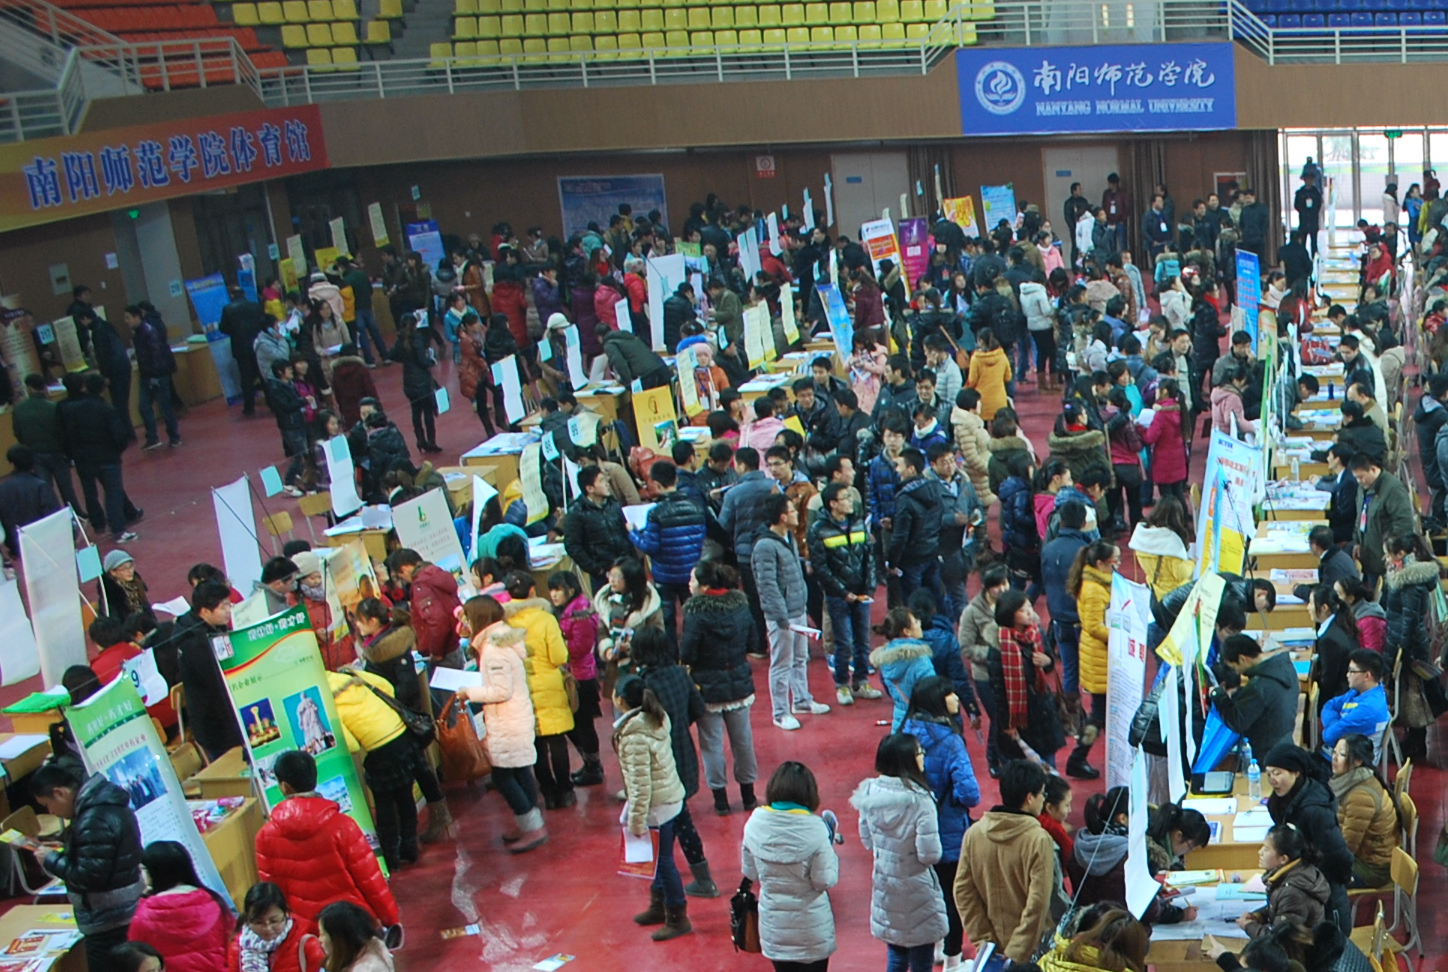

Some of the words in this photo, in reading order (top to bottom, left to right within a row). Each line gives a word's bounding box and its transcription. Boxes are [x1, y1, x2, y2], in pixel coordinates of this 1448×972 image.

[1033, 58, 1215, 97] 南阳师范学院
[1036, 100, 1092, 116] NANYANG
[1096, 99, 1144, 115] NORMAL
[1148, 98, 1215, 113] UNIVERSITY
[22, 119, 312, 210] 南阳师范学院体育馆
